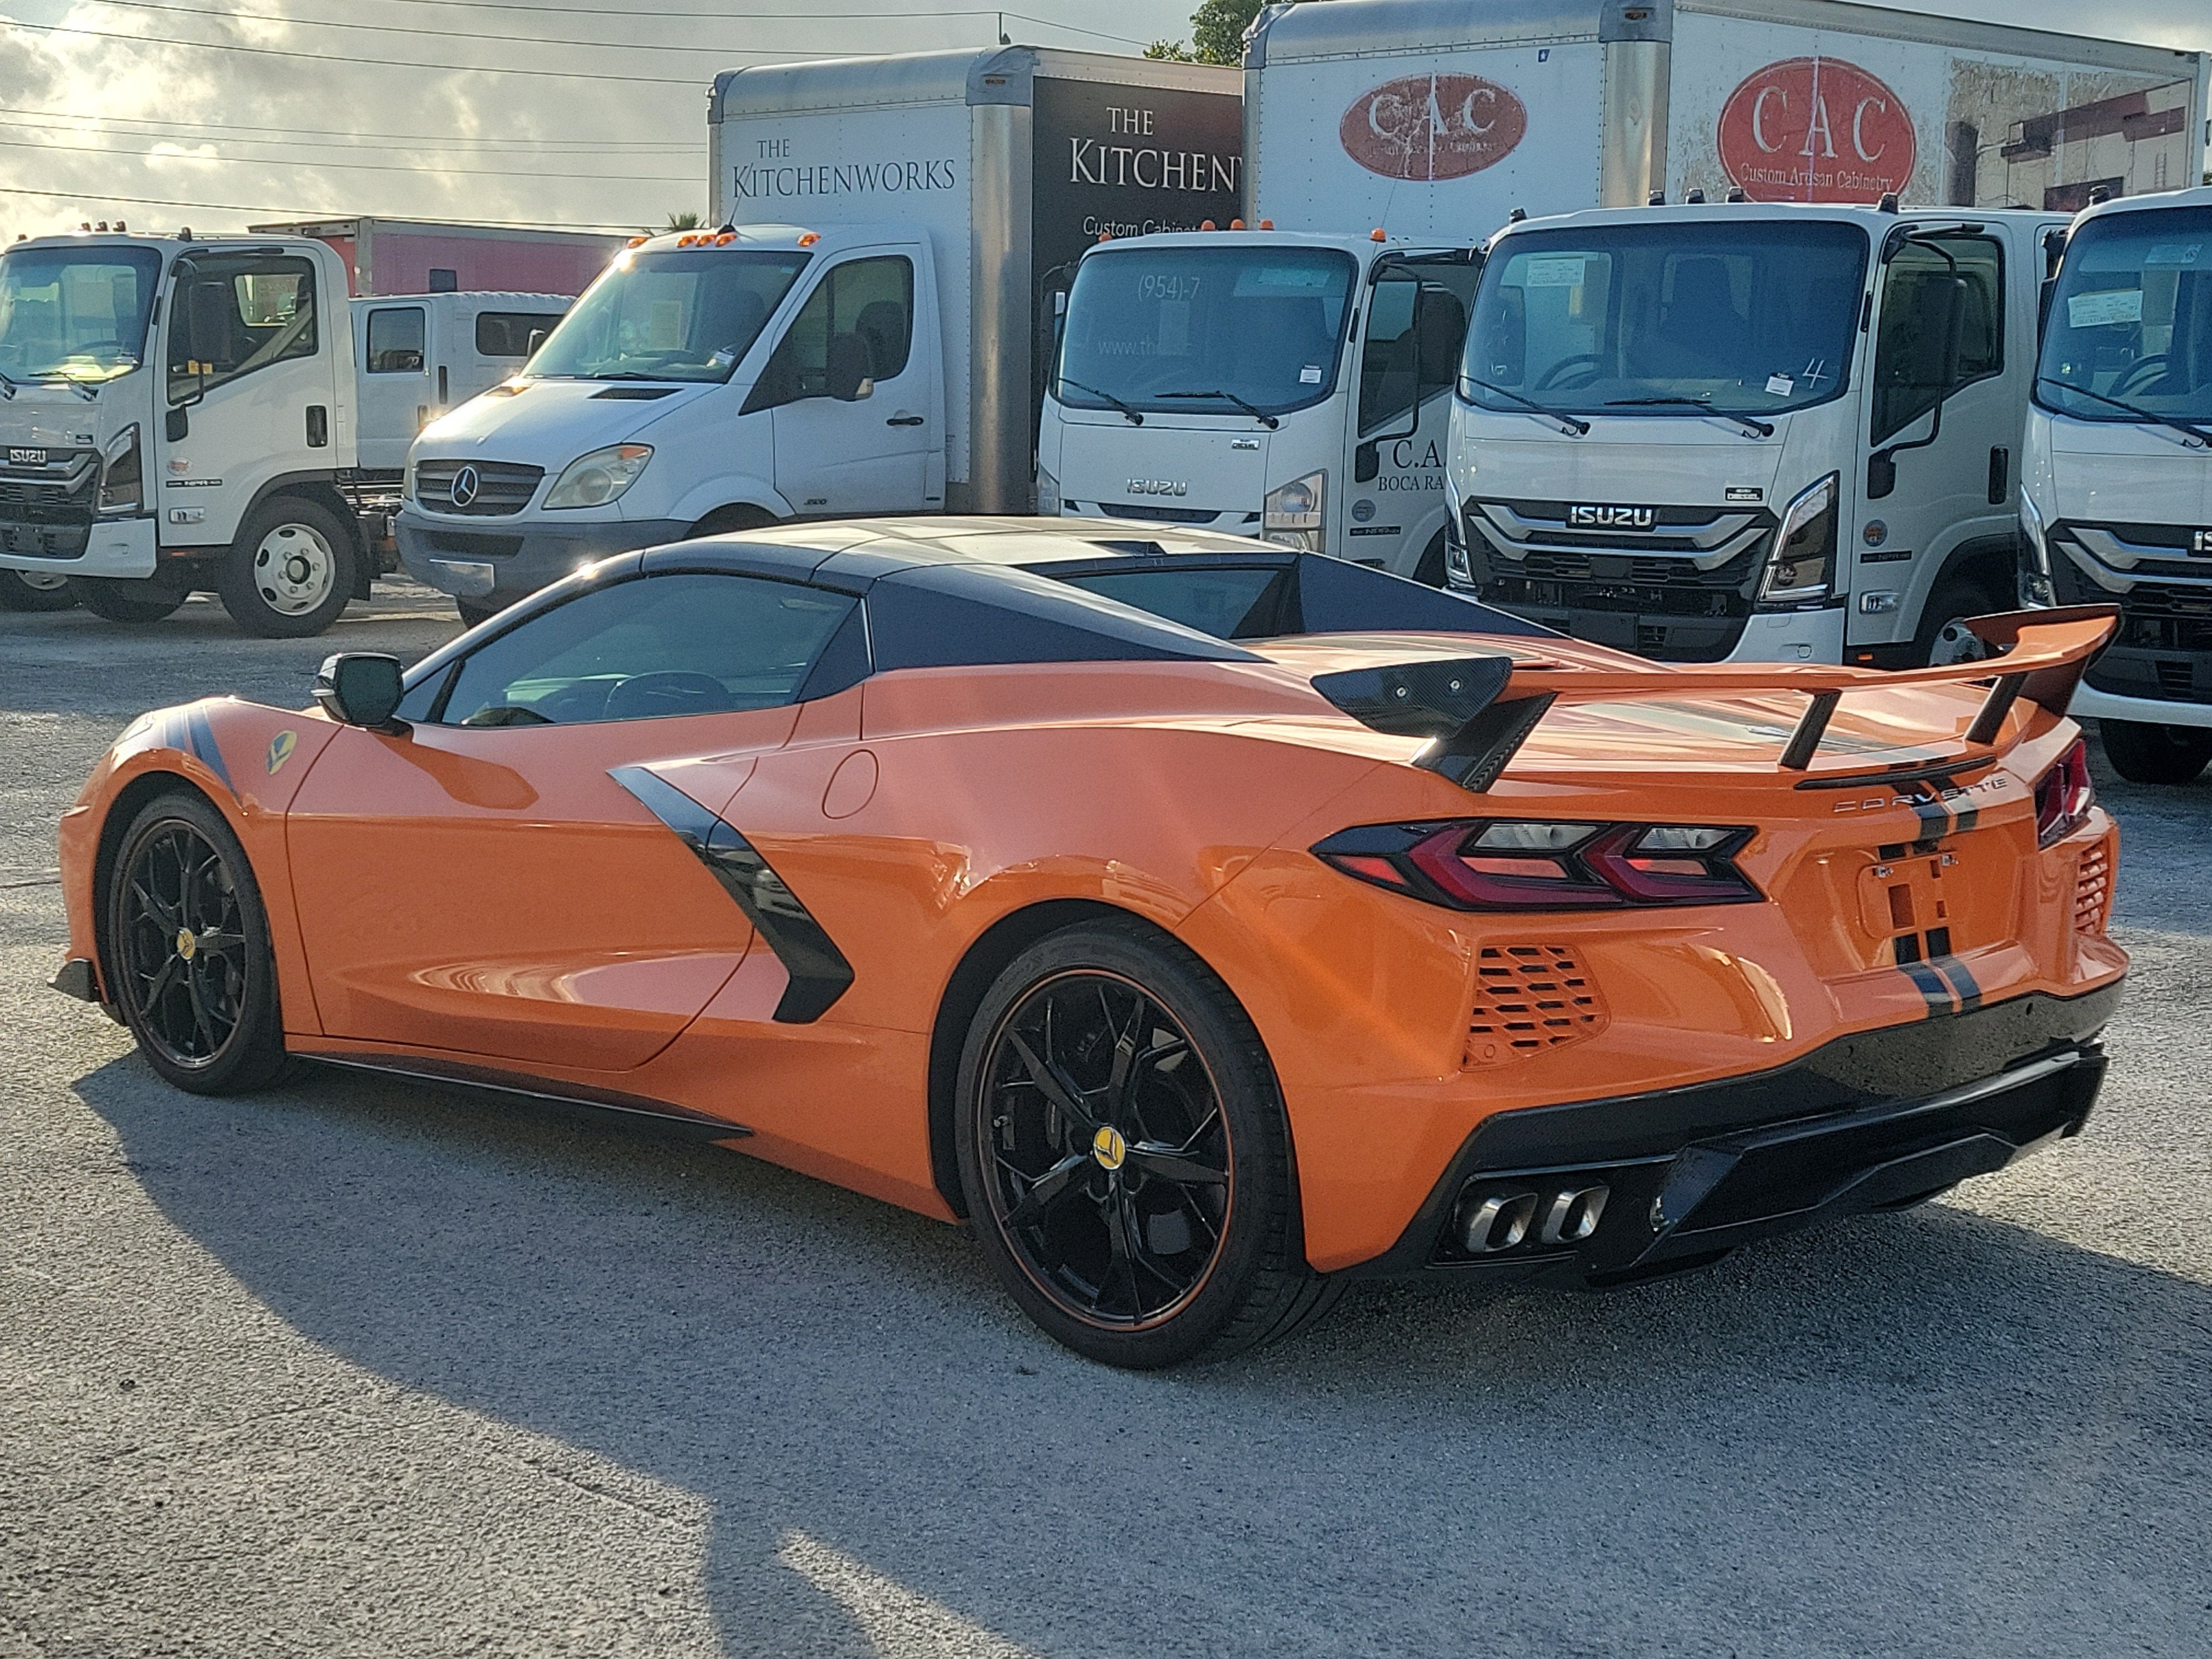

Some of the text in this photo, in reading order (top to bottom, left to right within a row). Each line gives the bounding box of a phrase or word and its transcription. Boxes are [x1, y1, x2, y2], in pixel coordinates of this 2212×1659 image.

[1106, 106, 1153, 136] THE
[757, 138, 790, 159] THE
[1069, 137, 1243, 193] KITCHEN
[1741, 163, 1787, 184] Custom
[732, 159, 955, 198] KITCHENWORKS
[1083, 216, 1138, 236] Custom
[1138, 275, 1200, 302] (954)-7
[1802, 358, 1829, 389] 4
[10, 449, 46, 463] ISUZU
[1126, 478, 1187, 496] ISUZU
[1378, 476, 1444, 491] BOCA RA
[1570, 506, 1652, 526] ISUZU
[1833, 776, 2007, 813] CORVETTE
